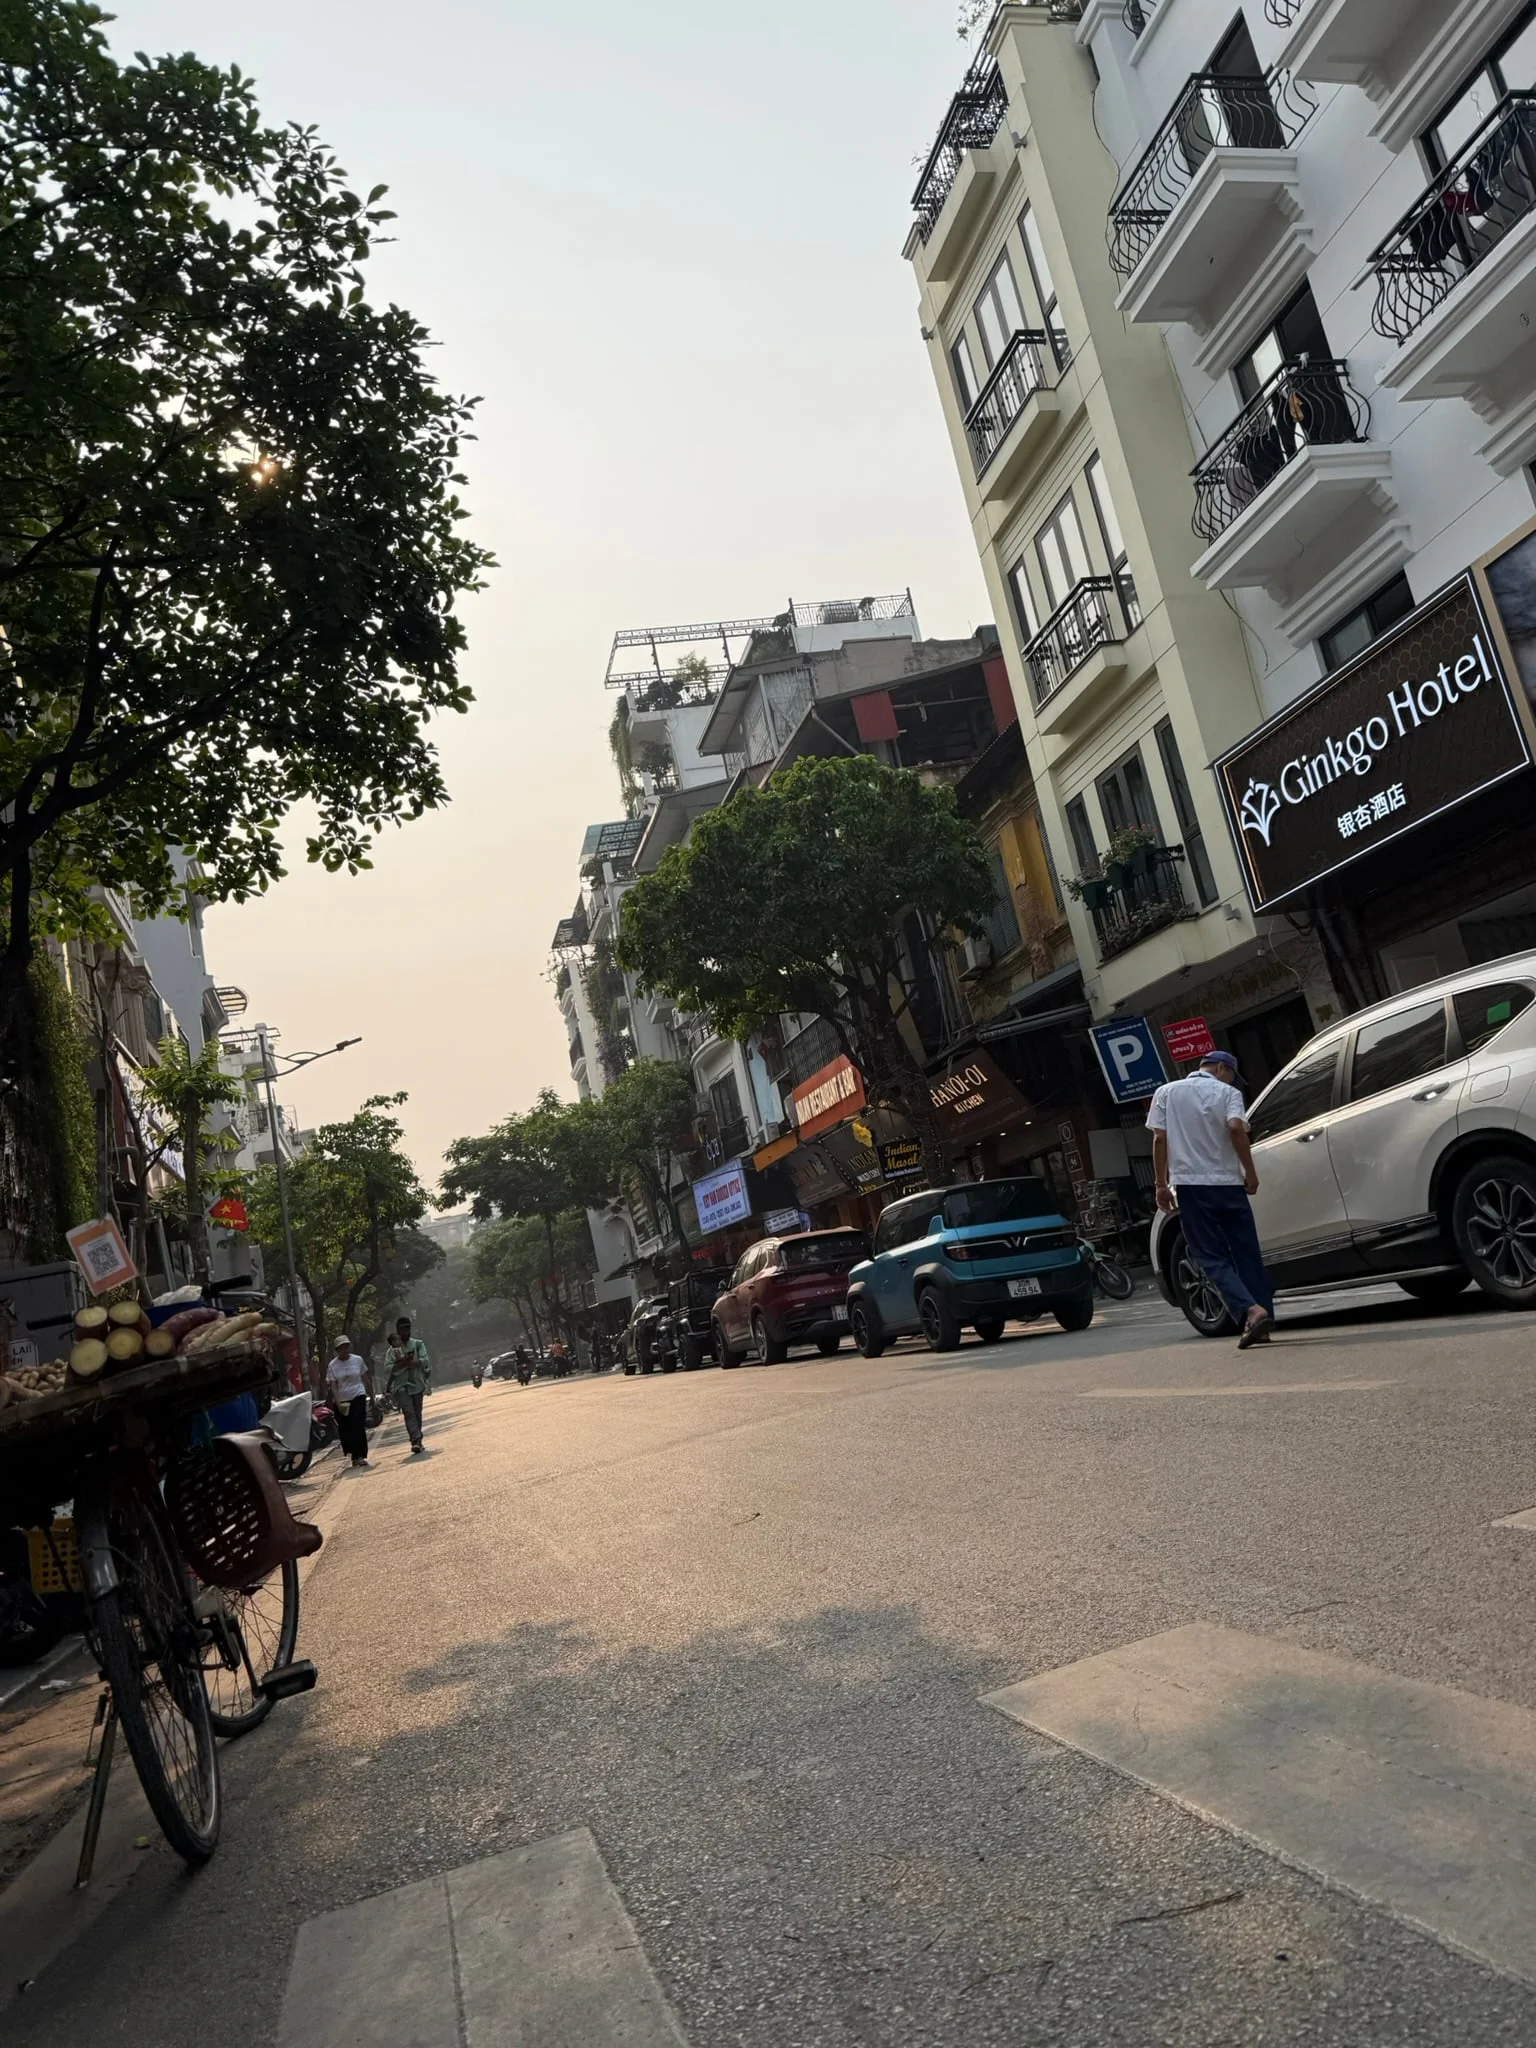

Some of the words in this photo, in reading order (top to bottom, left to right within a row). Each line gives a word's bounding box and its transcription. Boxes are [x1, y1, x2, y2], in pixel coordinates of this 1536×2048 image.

[1280, 716, 1389, 805] Ginkgo
[1387, 633, 1494, 737] Hotel
[1336, 781, 1407, 839] 银杏酒店
[1107, 1034, 1144, 1081] P
[953, 1093, 985, 1114] KITCHEN
[884, 1143, 919, 1157] Indian
